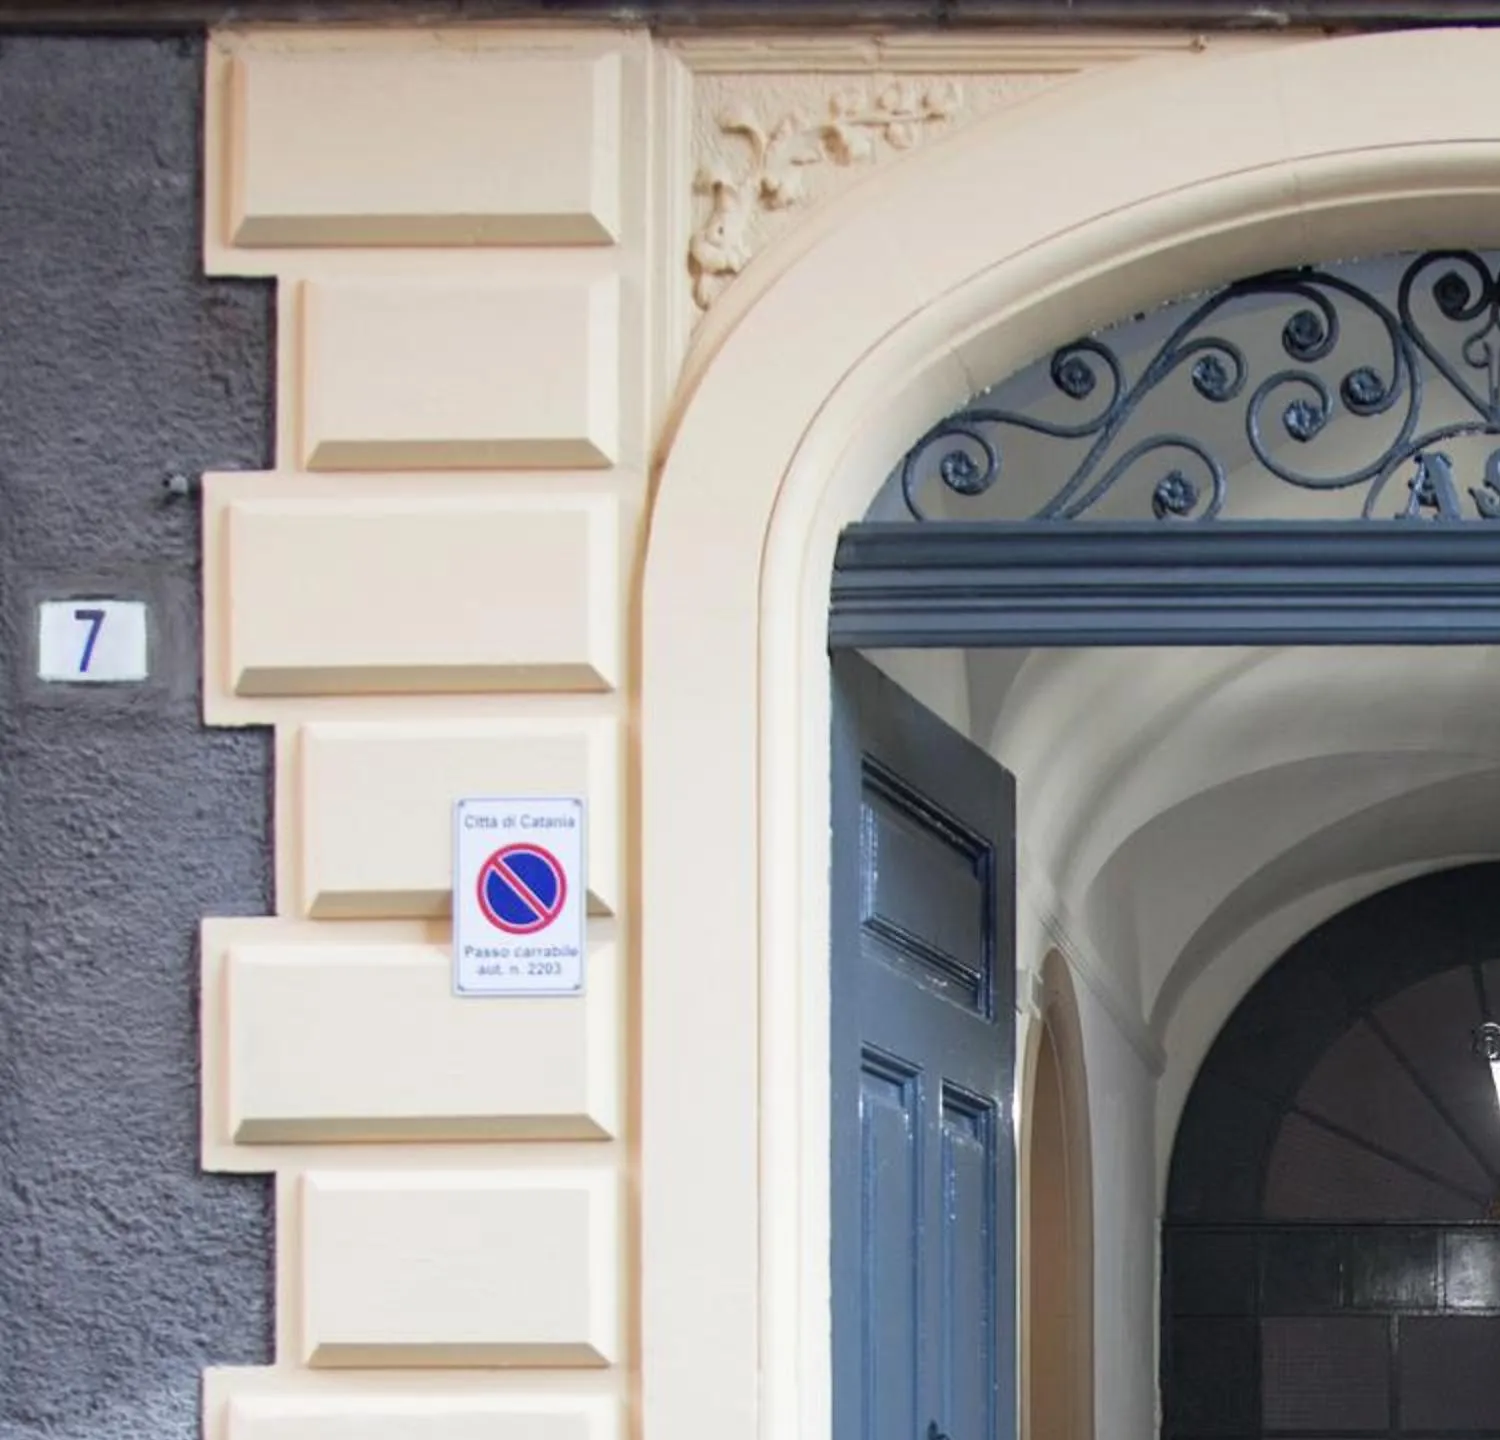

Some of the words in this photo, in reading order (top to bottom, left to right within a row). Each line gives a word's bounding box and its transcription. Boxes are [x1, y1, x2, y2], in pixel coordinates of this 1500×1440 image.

[74, 609, 106, 672] 7
[502, 814, 516, 829] di
[519, 813, 576, 829] Catania
[464, 945, 510, 958] Passo
[513, 944, 579, 958] carrabile
[527, 962, 561, 976] 2203
